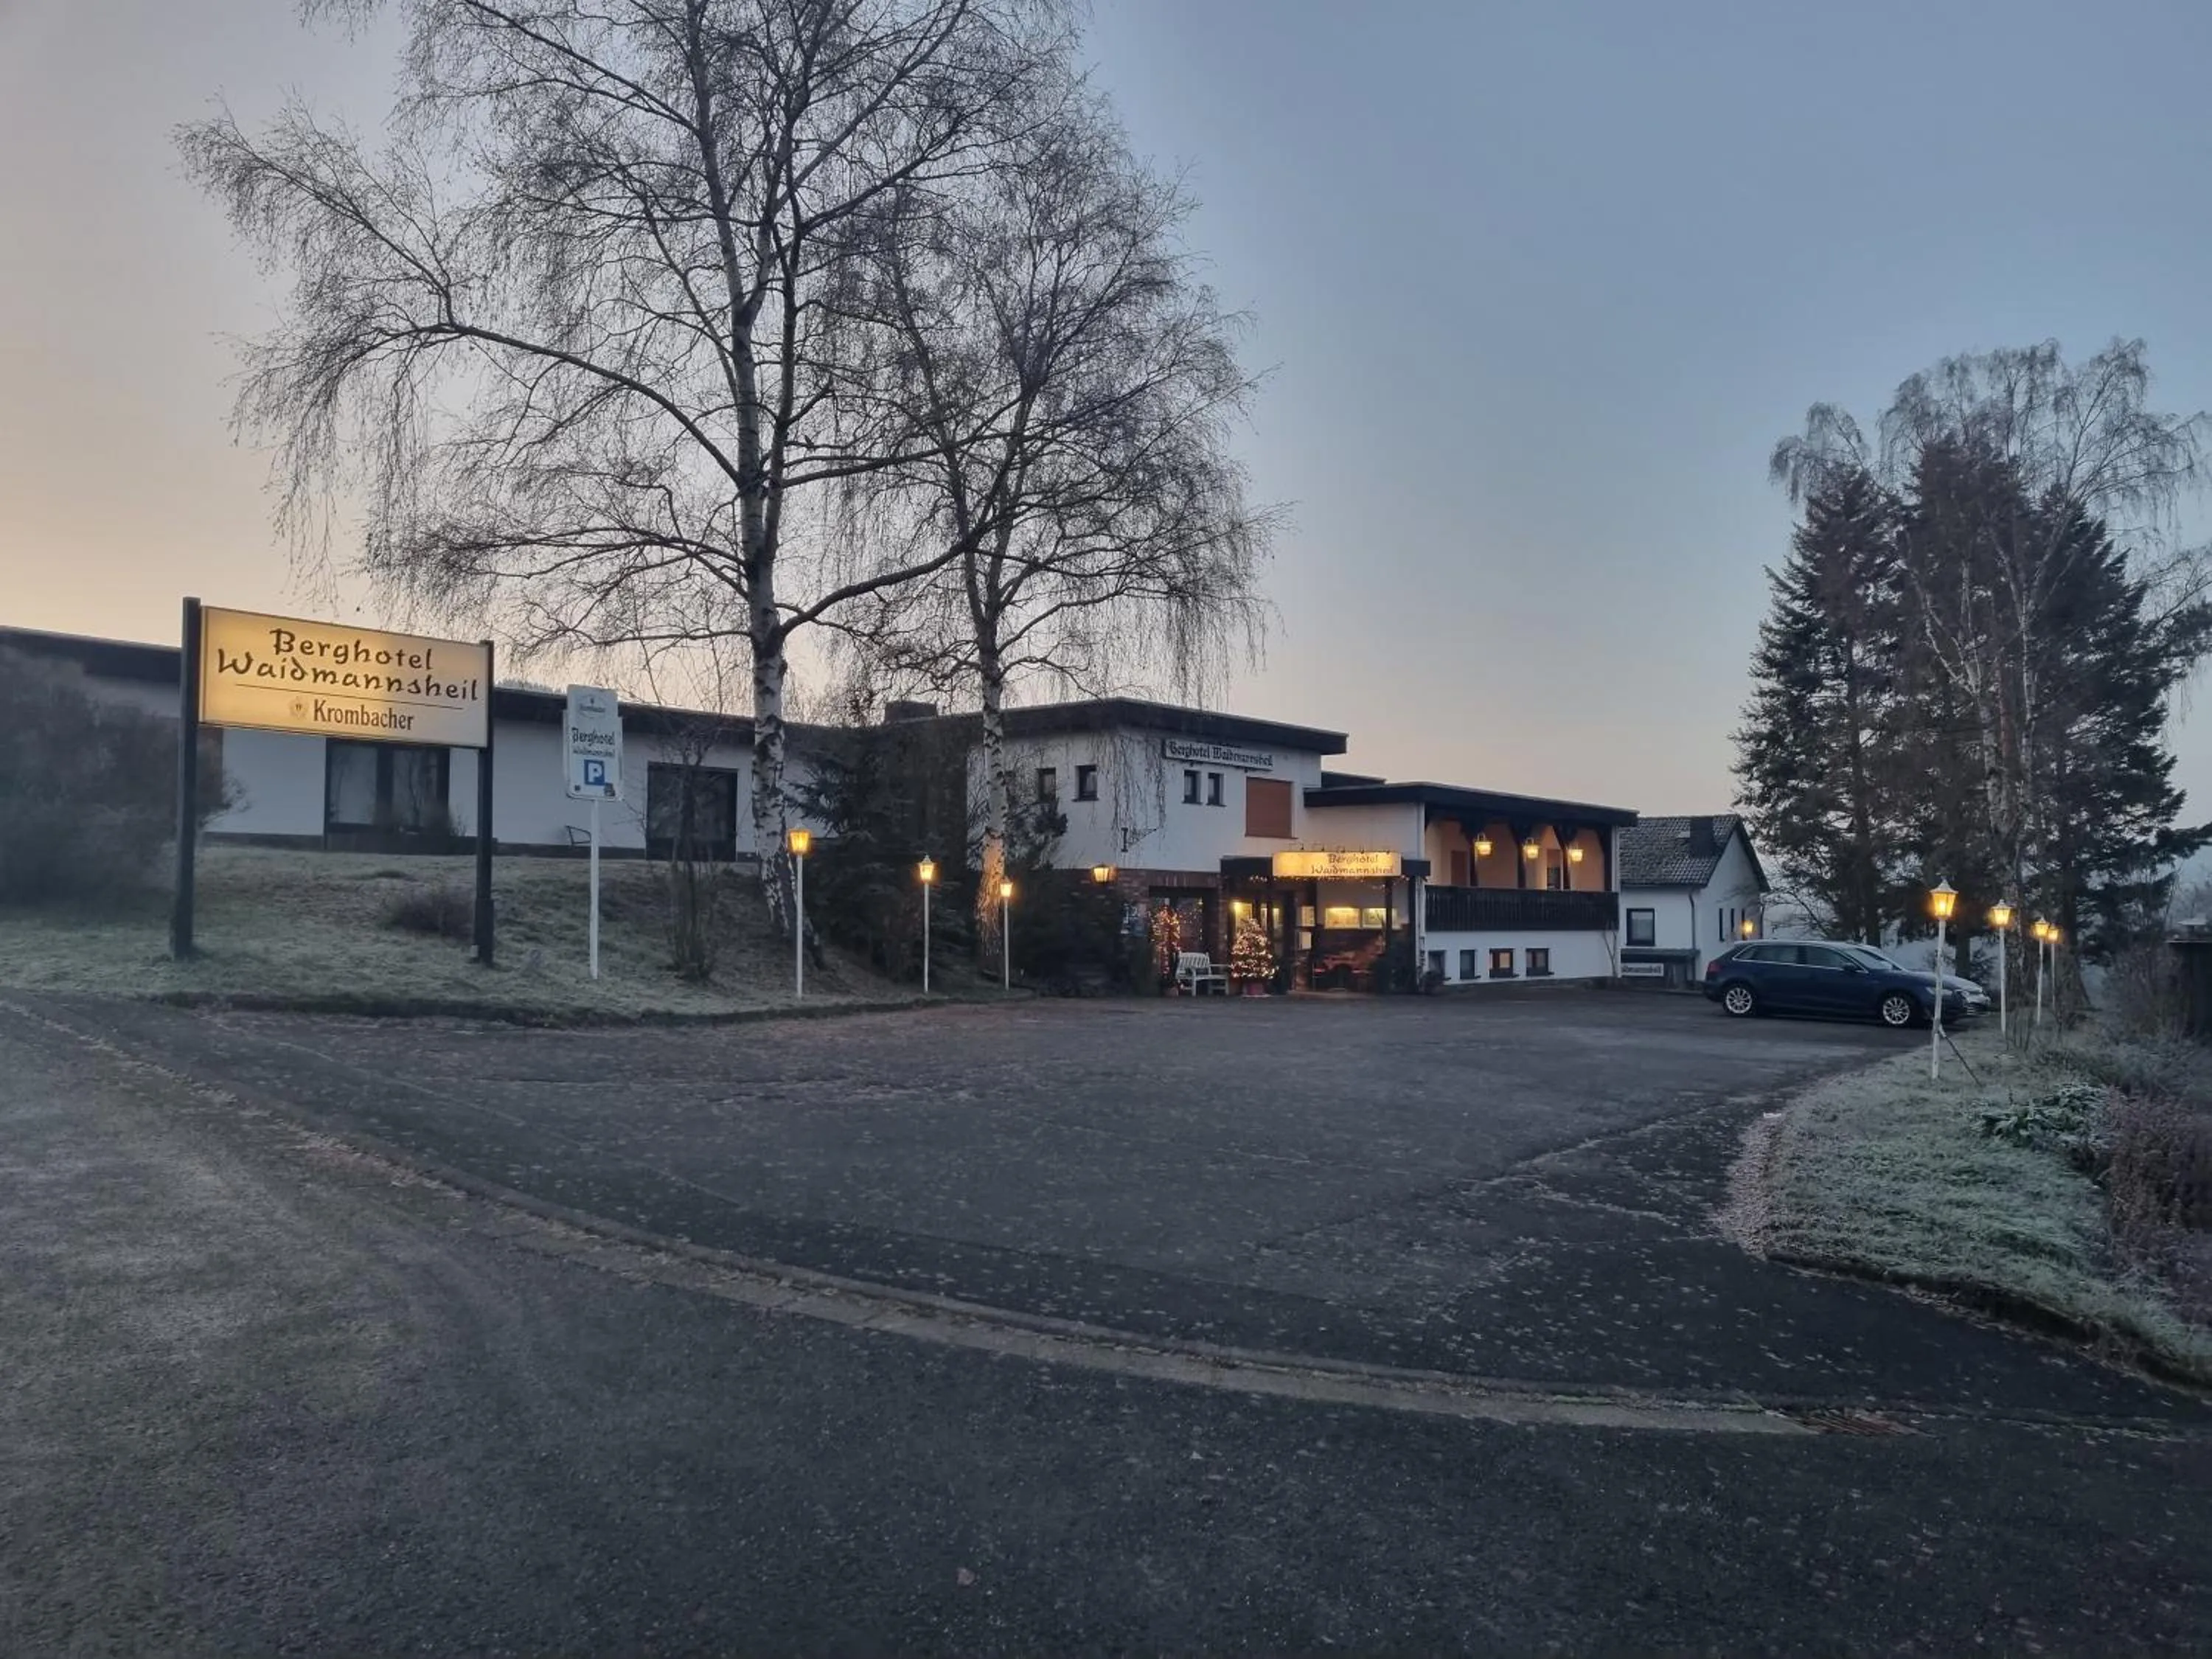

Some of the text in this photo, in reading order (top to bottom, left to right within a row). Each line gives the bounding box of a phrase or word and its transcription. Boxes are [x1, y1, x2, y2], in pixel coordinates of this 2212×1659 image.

[270, 628, 433, 669] Berghotel
[218, 649, 479, 700] Waidmannsheil
[313, 698, 414, 730] Krombacher
